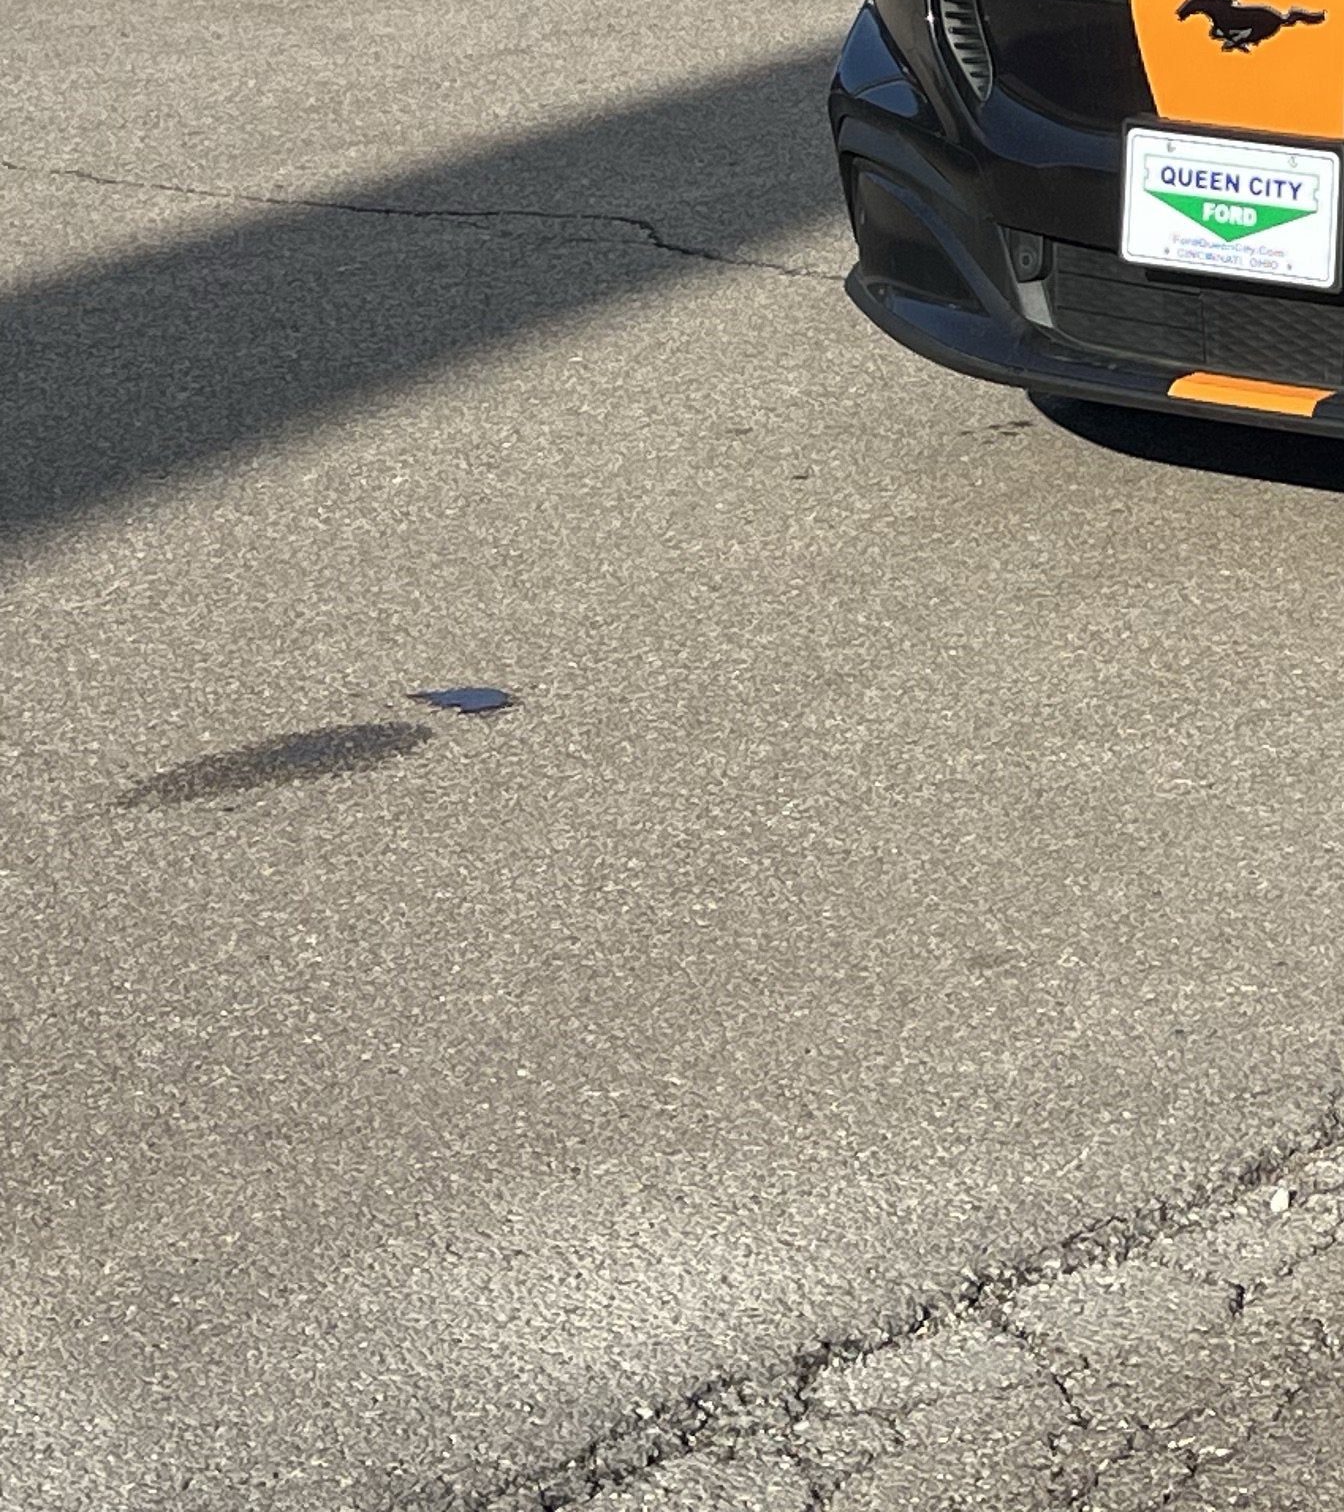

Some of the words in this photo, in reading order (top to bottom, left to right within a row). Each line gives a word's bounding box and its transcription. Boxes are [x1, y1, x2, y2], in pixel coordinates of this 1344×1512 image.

[1161, 165, 1240, 193] QUEEN
[1249, 177, 1302, 200] CITY
[1202, 202, 1258, 227] FORD
